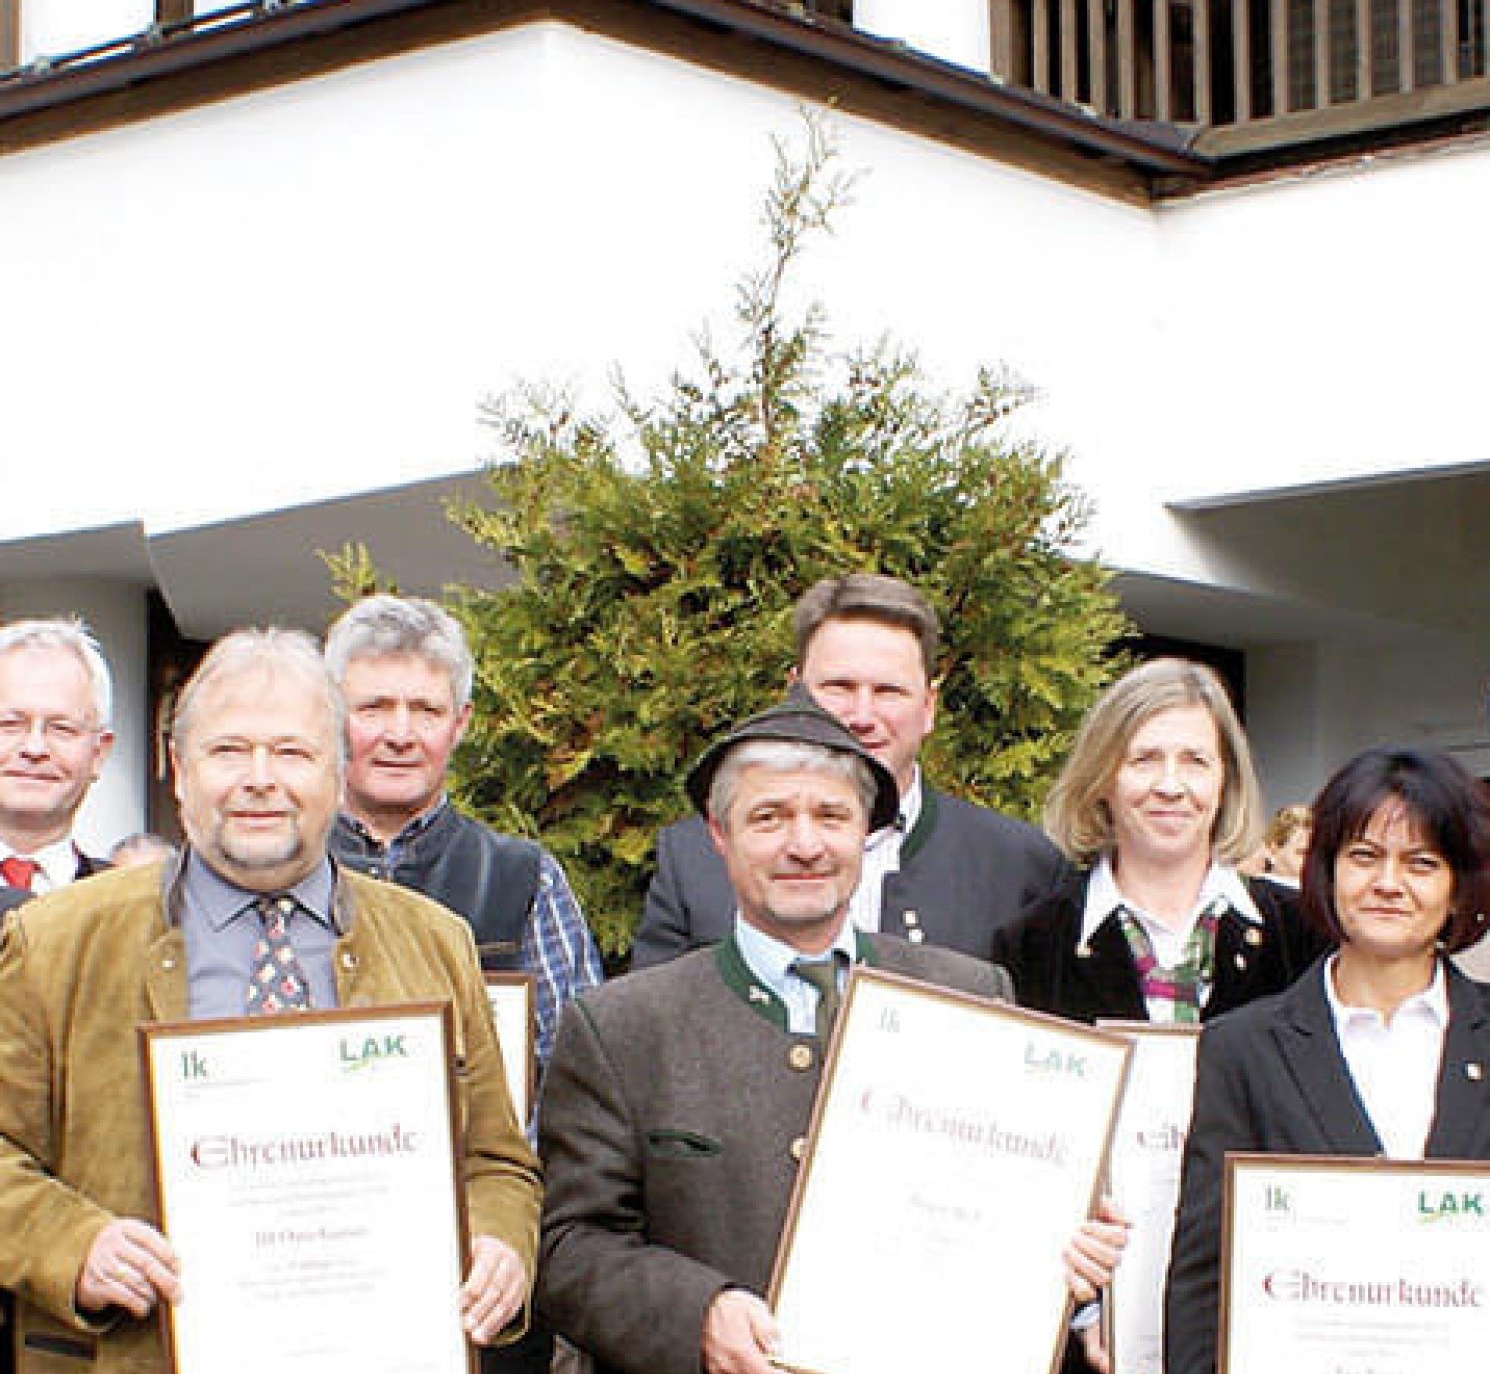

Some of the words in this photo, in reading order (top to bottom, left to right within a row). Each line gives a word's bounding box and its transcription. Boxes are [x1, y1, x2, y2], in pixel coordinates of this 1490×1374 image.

[338, 1033, 409, 1063] LAK
[1024, 1041, 1089, 1077] LAK
[1417, 1190, 1485, 1217] LAK
